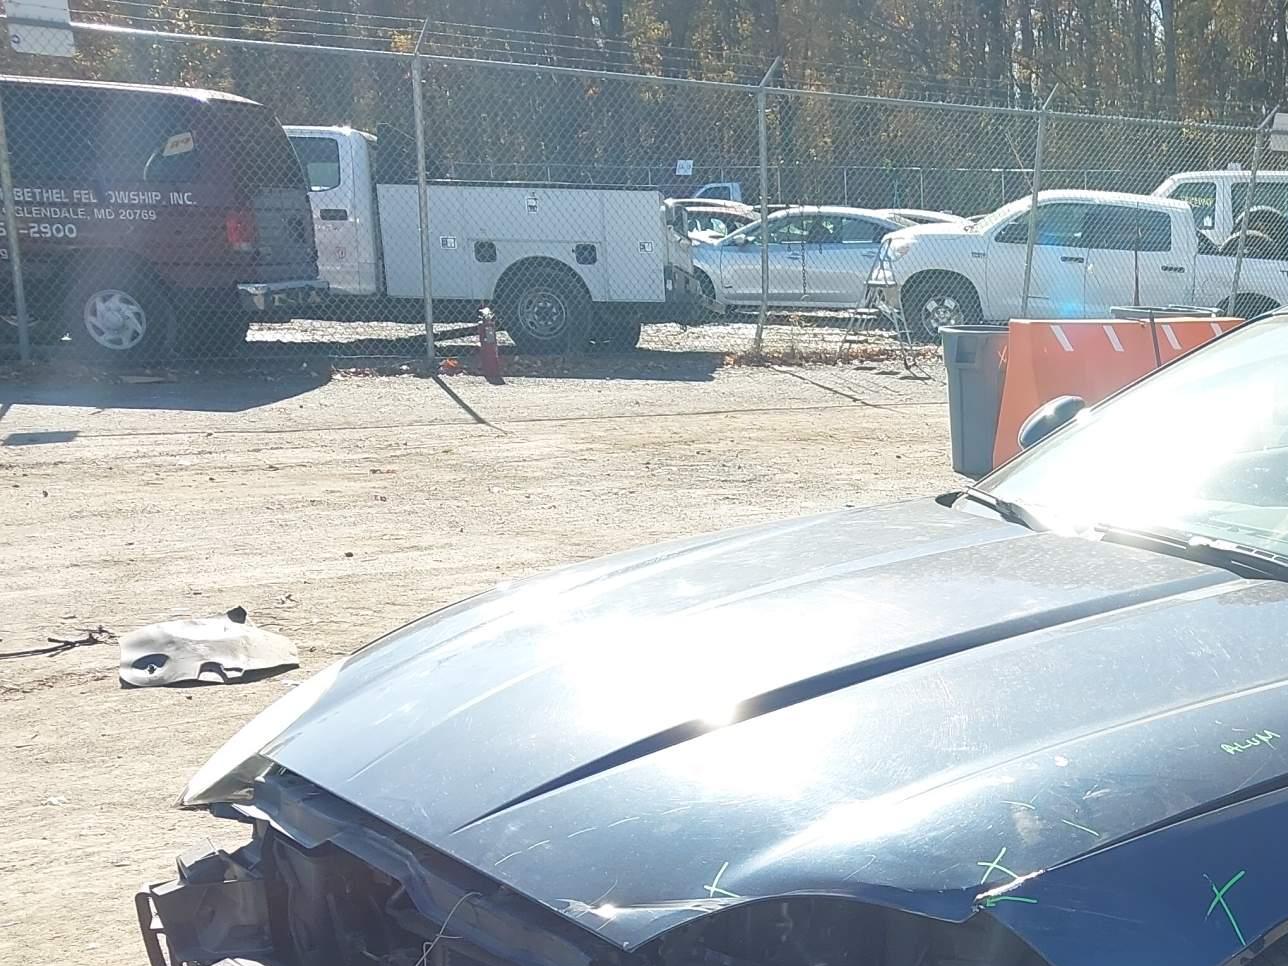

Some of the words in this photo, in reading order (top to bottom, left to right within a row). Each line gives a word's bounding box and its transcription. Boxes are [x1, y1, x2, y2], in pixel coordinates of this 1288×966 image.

[13, 188, 69, 202] BETHEL
[169, 191, 197, 205] INC.
[94, 208, 115, 219] MD
[119, 209, 157, 220] 20769
[1220, 729, 1281, 755] ALUM
